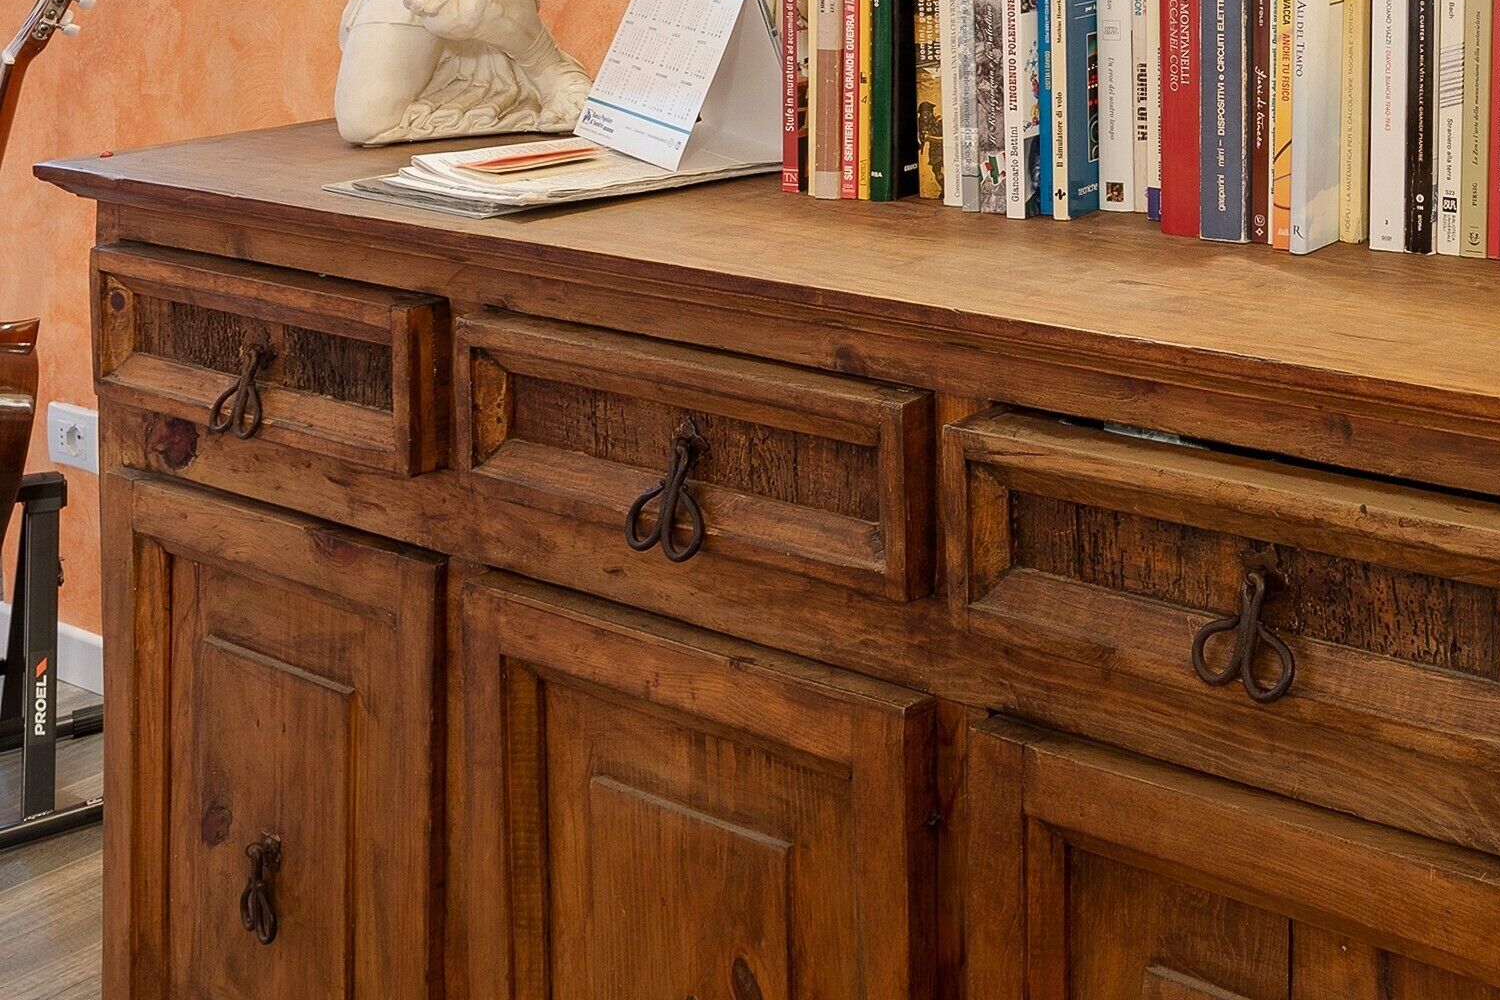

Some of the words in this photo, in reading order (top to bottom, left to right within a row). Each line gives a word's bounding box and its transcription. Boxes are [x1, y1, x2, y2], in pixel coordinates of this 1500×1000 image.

[786, 12, 794, 44] accumulo
[1282, 0, 1291, 25] VACCA
[845, 15, 855, 51] GUERRA
[1169, 27, 1178, 51] NEL
[1180, 4, 1190, 84] MONTANELLI
[1282, 33, 1291, 61] ANCHE
[786, 45, 794, 54] ad
[785, 57, 794, 96] muratura
[845, 53, 854, 90] GRANDE
[1169, 55, 1178, 91] CORO
[1282, 62, 1290, 75] TU
[1009, 59, 1018, 111] L'INGENUO
[1281, 75, 1290, 101] FISICO
[785, 97, 794, 107] in
[844, 92, 854, 119] DELLA
[785, 107, 795, 132] Stufe
[844, 121, 854, 161] SENTIERI
[1010, 126, 1019, 157] Bettini
[844, 165, 854, 181] SUI
[1216, 148, 1225, 167] mirri
[1010, 159, 1019, 202] Giancarlo
[1216, 174, 1227, 211] gasparini
[35, 675, 47, 736] PROEL
